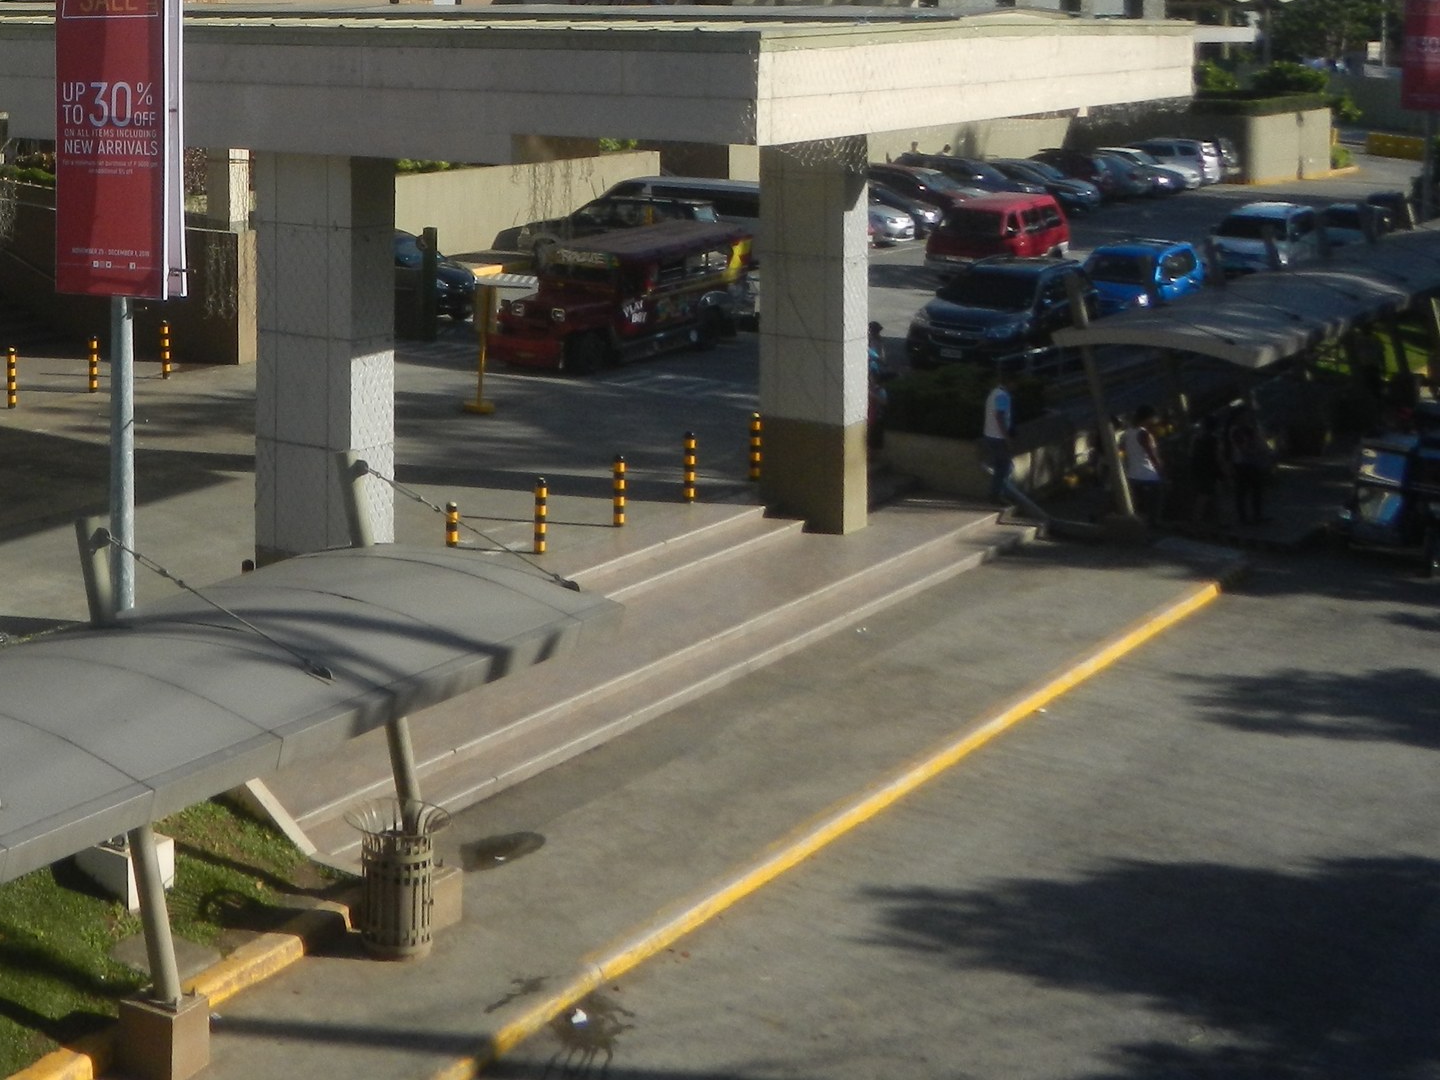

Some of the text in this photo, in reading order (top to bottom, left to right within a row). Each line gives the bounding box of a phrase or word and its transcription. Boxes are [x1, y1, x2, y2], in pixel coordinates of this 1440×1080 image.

[62, 81, 86, 102] UP
[62, 104, 156, 127] TO OFF
[64, 129, 157, 139] ON ALL ITEMS INCLUDING
[64, 139, 158, 156] NEW ARRIVALS
